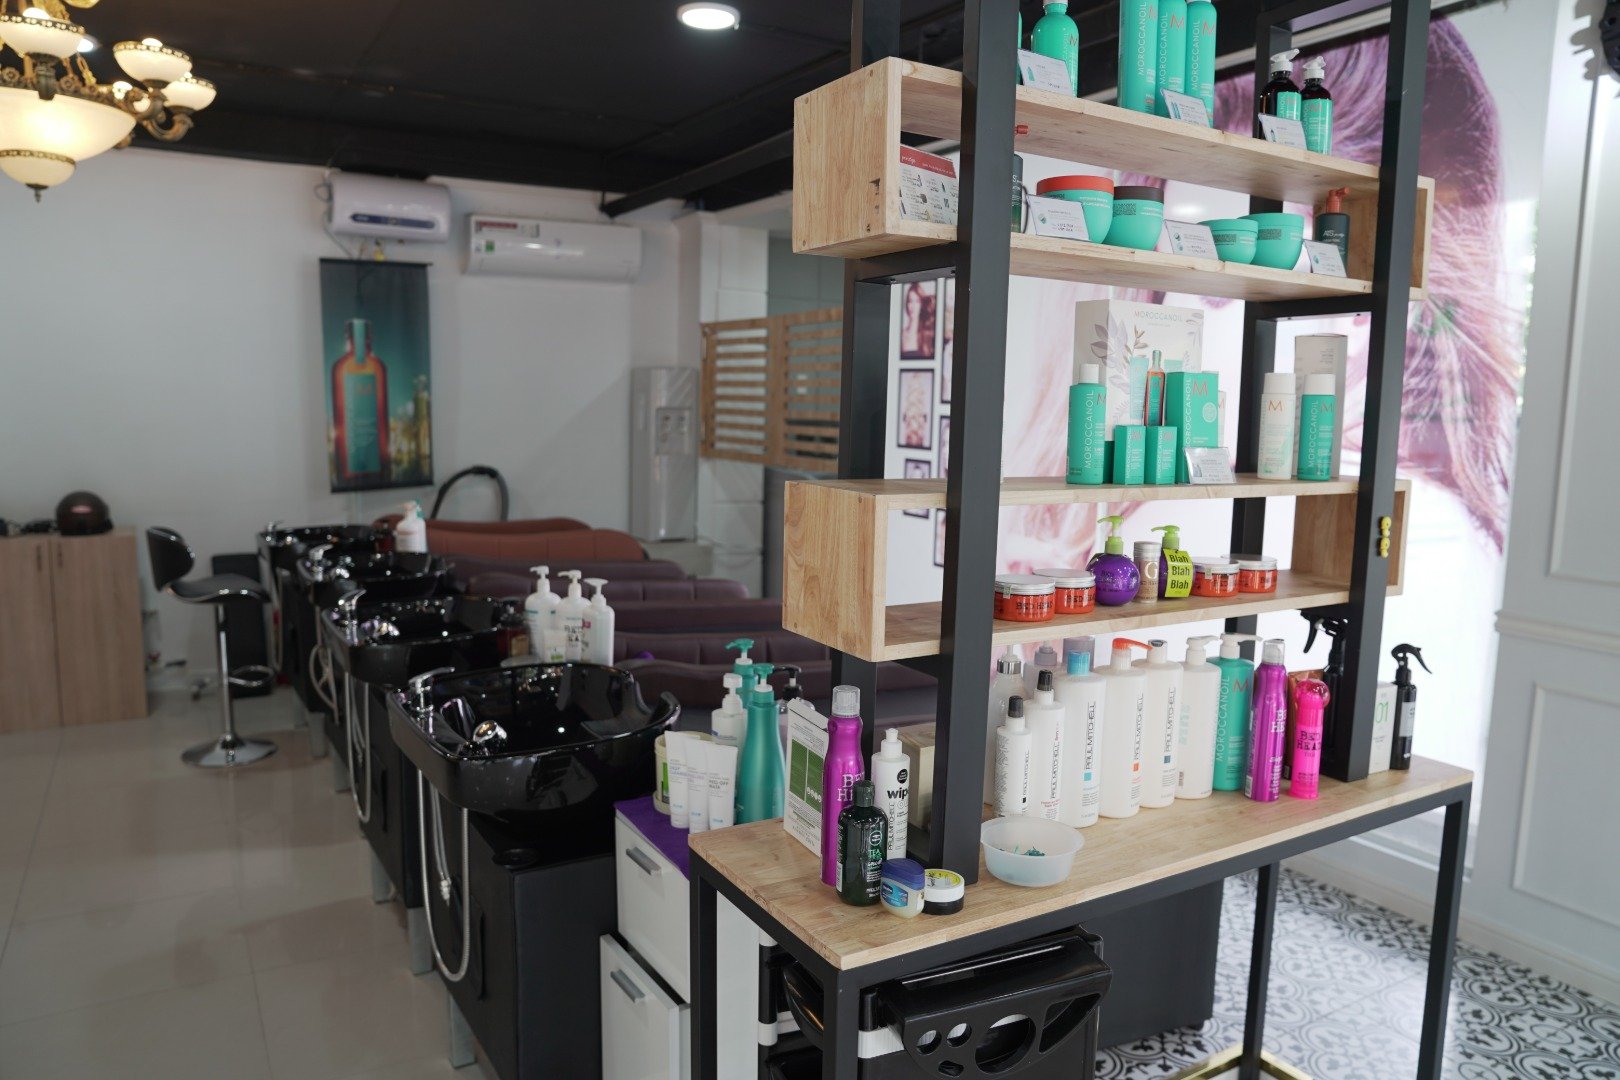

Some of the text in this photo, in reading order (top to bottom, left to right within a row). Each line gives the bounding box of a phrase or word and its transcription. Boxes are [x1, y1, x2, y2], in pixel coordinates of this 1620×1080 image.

[1170, 14, 1184, 30] M
[1202, 21, 1215, 36] M
[1138, 2, 1147, 76] MOROCCANOIL
[1160, 13, 1168, 85] MOROCCANOIL
[1192, 21, 1200, 90] MOROCCANOIL
[1134, 310, 1183, 322] MOROCCANOIL
[1192, 379, 1209, 397] M
[1268, 401, 1283, 411] M
[1084, 390, 1094, 469] MOROCCANOIL
[1308, 401, 1319, 468] MOROCCANOIL
[1169, 555, 1189, 563] Blah
[1144, 561, 1158, 579] G
[1171, 565, 1190, 576] Blah
[1170, 579, 1189, 589] Blah
[1233, 679, 1249, 693] M
[1216, 677, 1230, 761] MOROCCANOIL
[1375, 701, 1389, 723] 01
